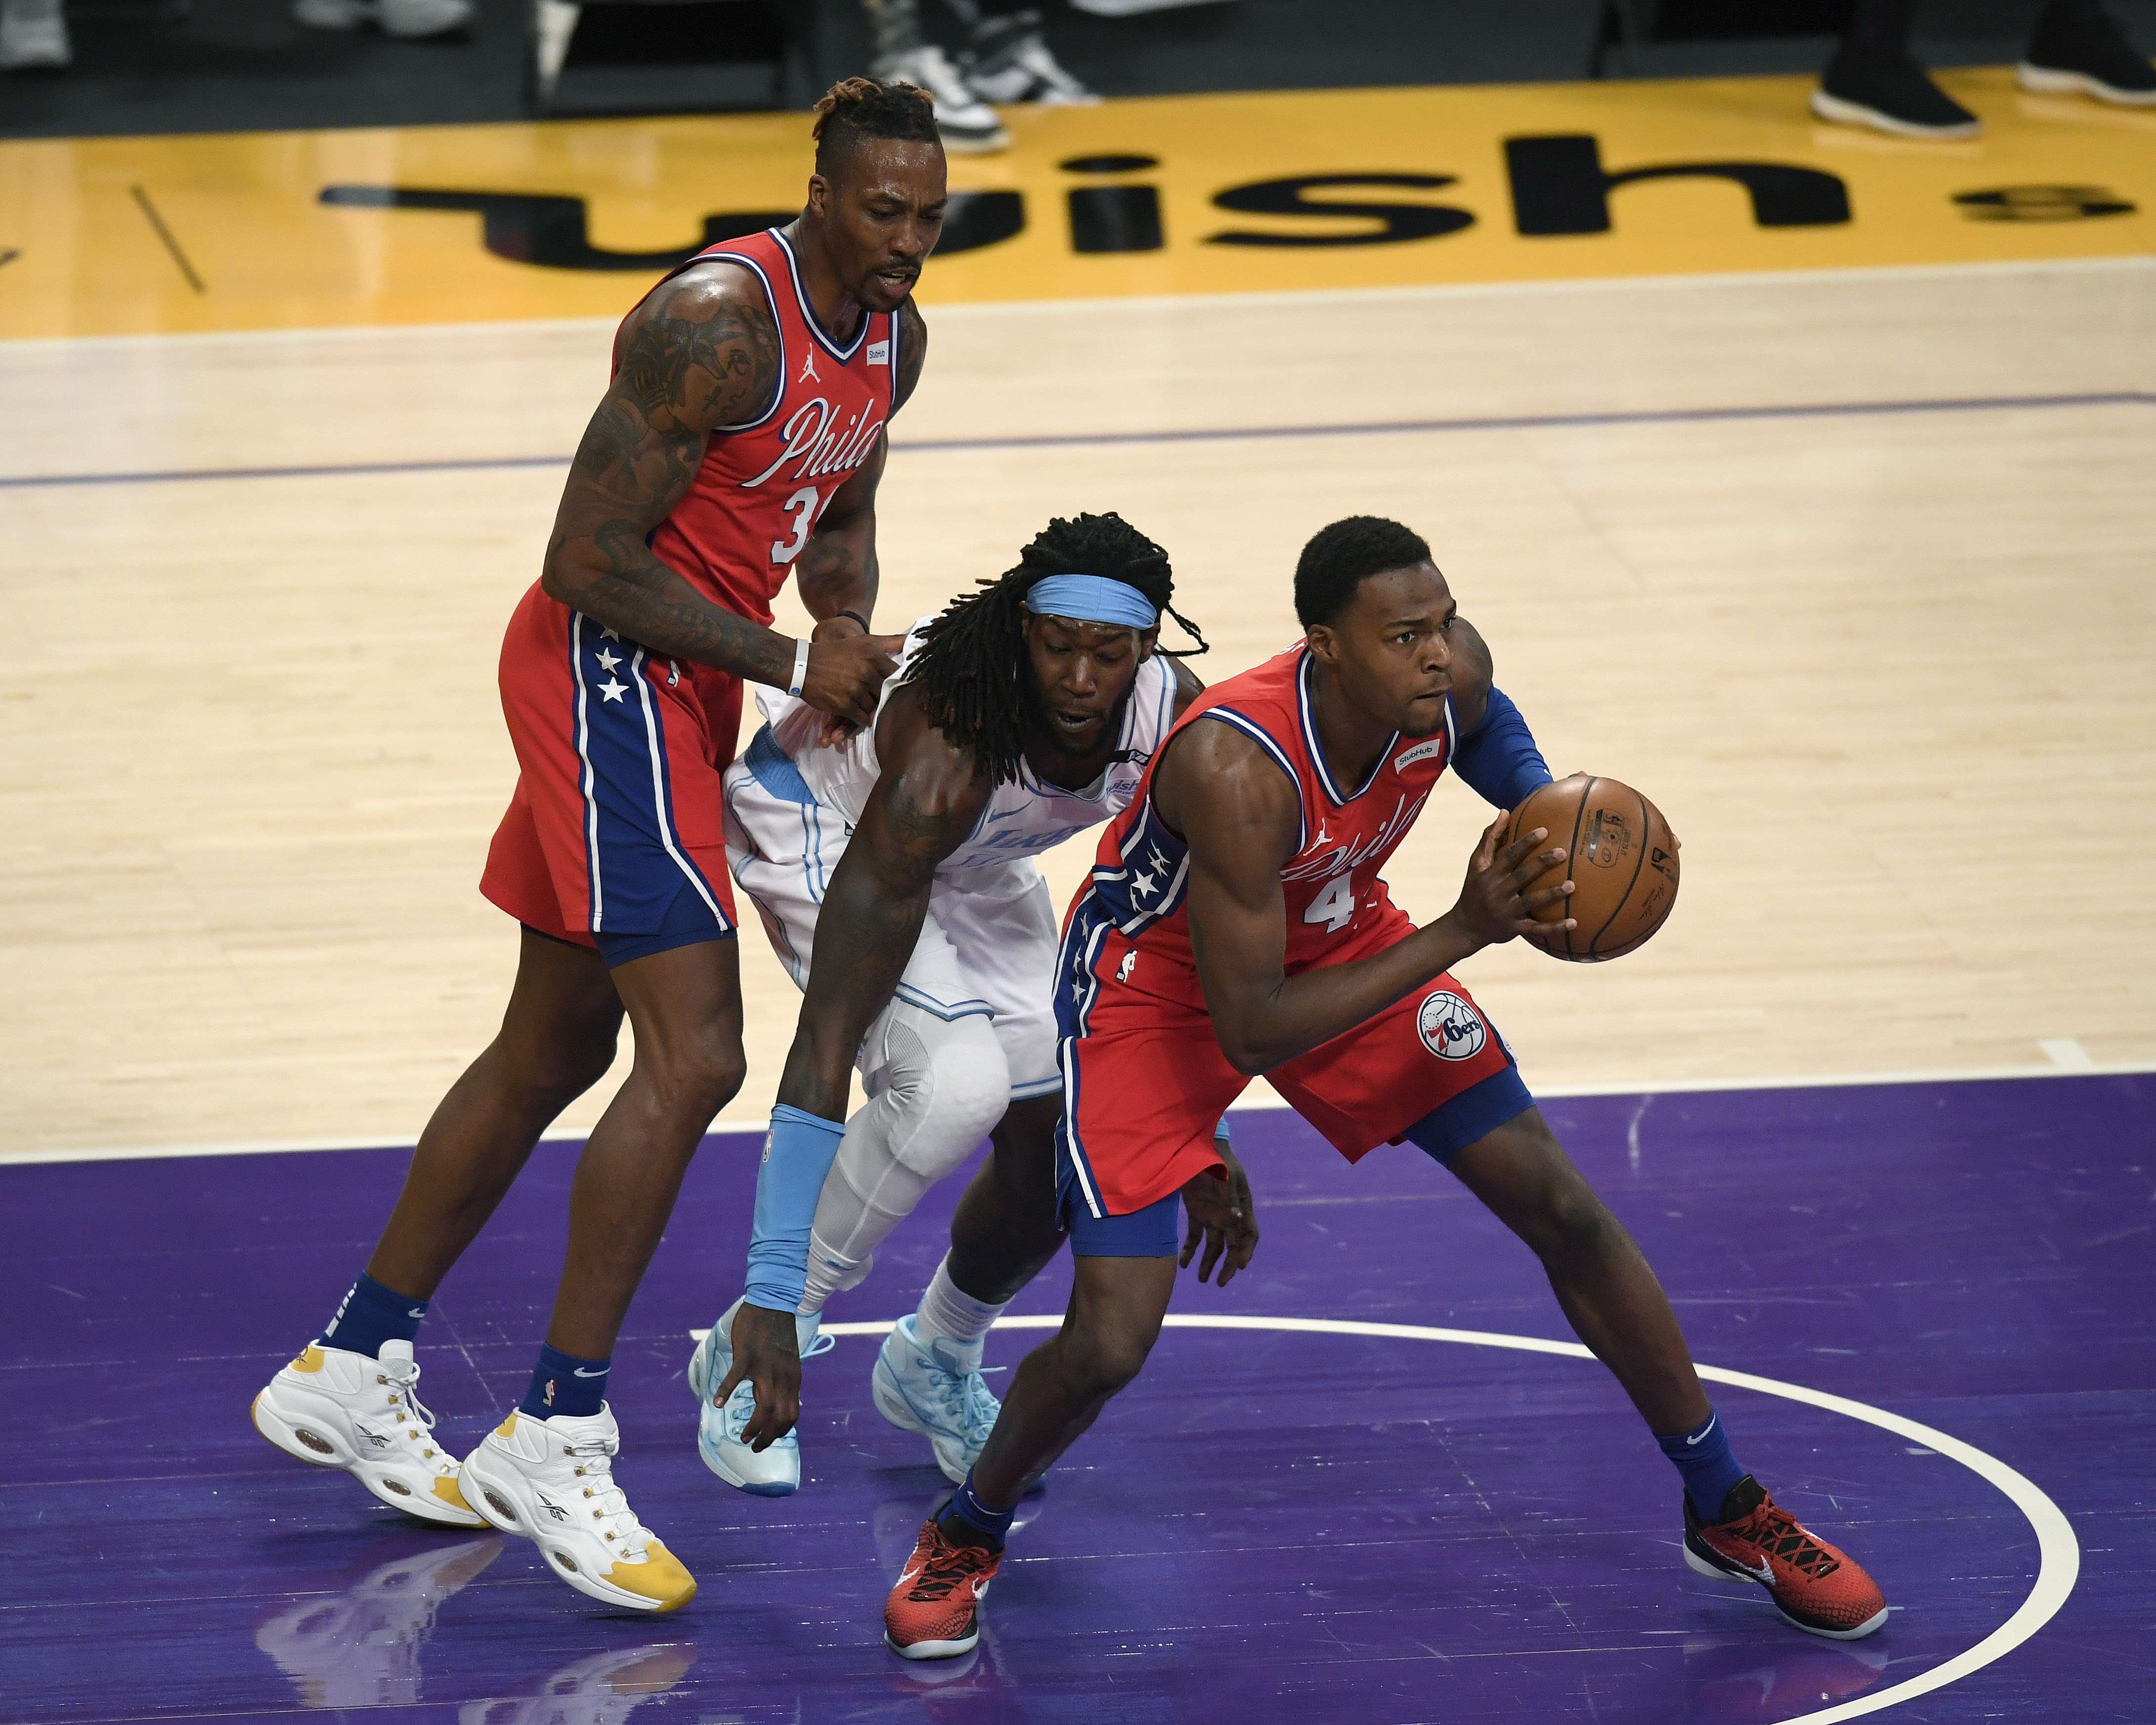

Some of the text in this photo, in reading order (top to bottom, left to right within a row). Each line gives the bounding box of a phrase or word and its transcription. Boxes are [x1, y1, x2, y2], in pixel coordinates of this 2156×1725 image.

[318, 133, 1854, 272] wish
[736, 397, 884, 487] Phila
[771, 485, 840, 564] 3
[1399, 746, 1432, 765] StubHub
[1303, 869, 1355, 934] 4
[1426, 1017, 1480, 1052] 76ers
